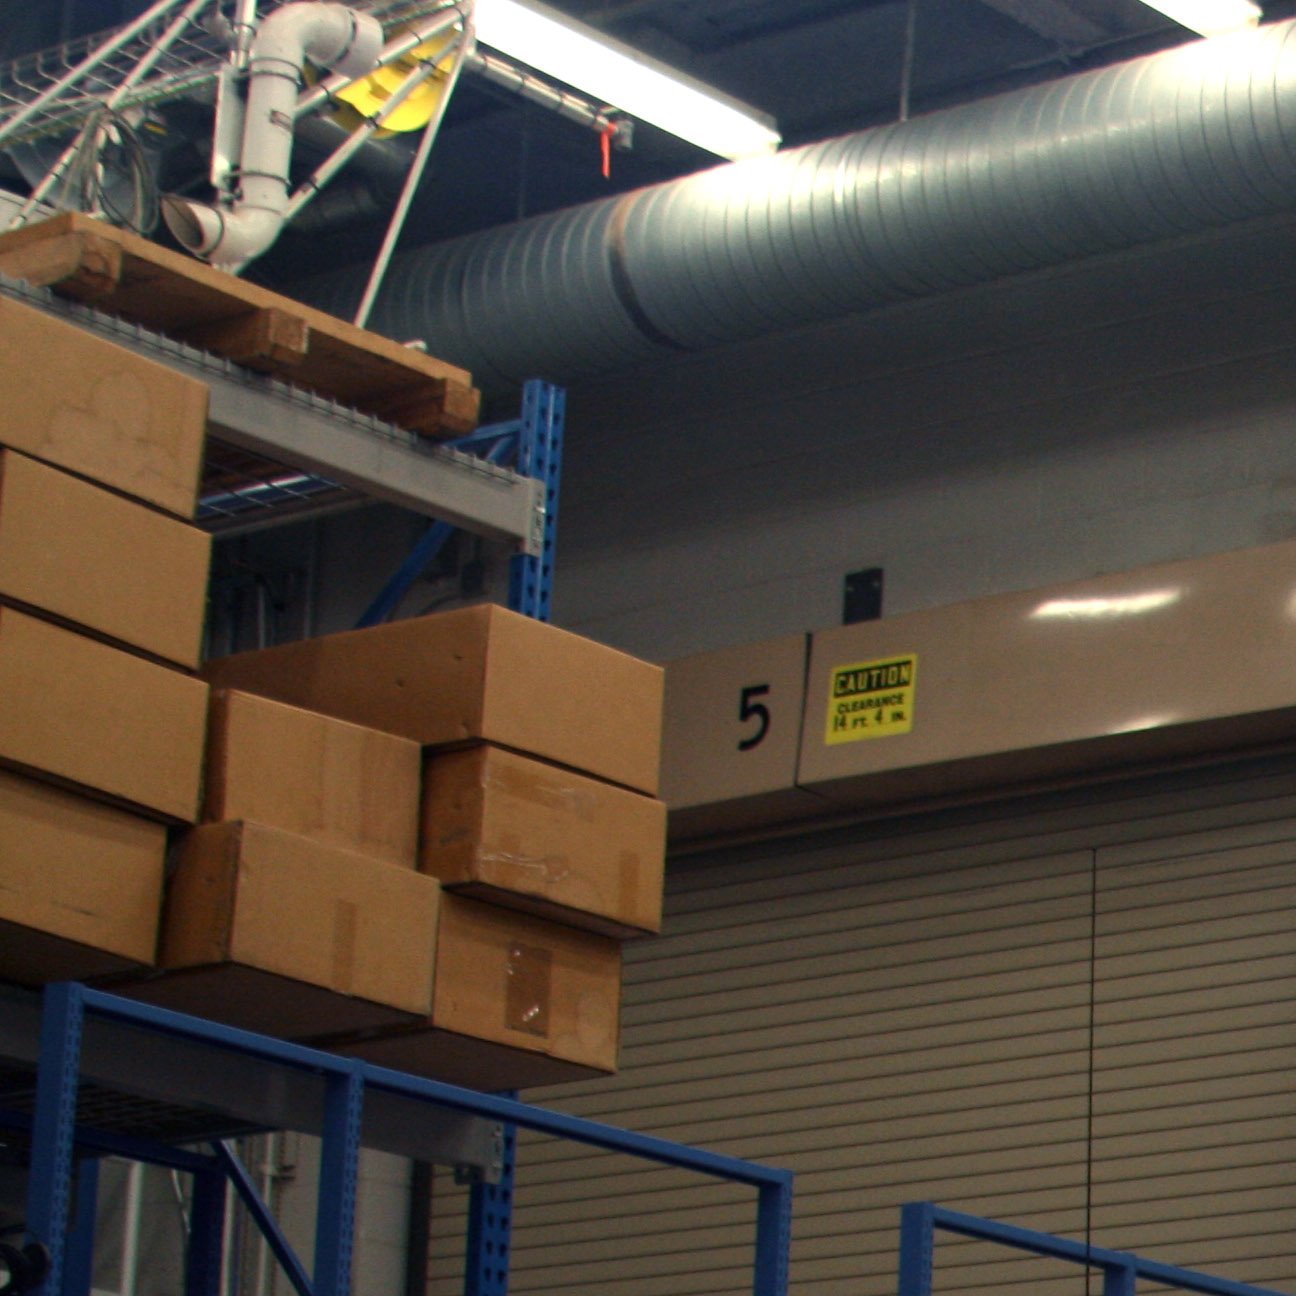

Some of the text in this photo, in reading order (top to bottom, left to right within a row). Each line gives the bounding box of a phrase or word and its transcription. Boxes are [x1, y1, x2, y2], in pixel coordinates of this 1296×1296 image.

[836, 663, 912, 694] CAUTION
[837, 693, 905, 715] CLEARANCE
[738, 684, 770, 751] 5
[833, 710, 906, 732] 14 FT. 4 IN.
